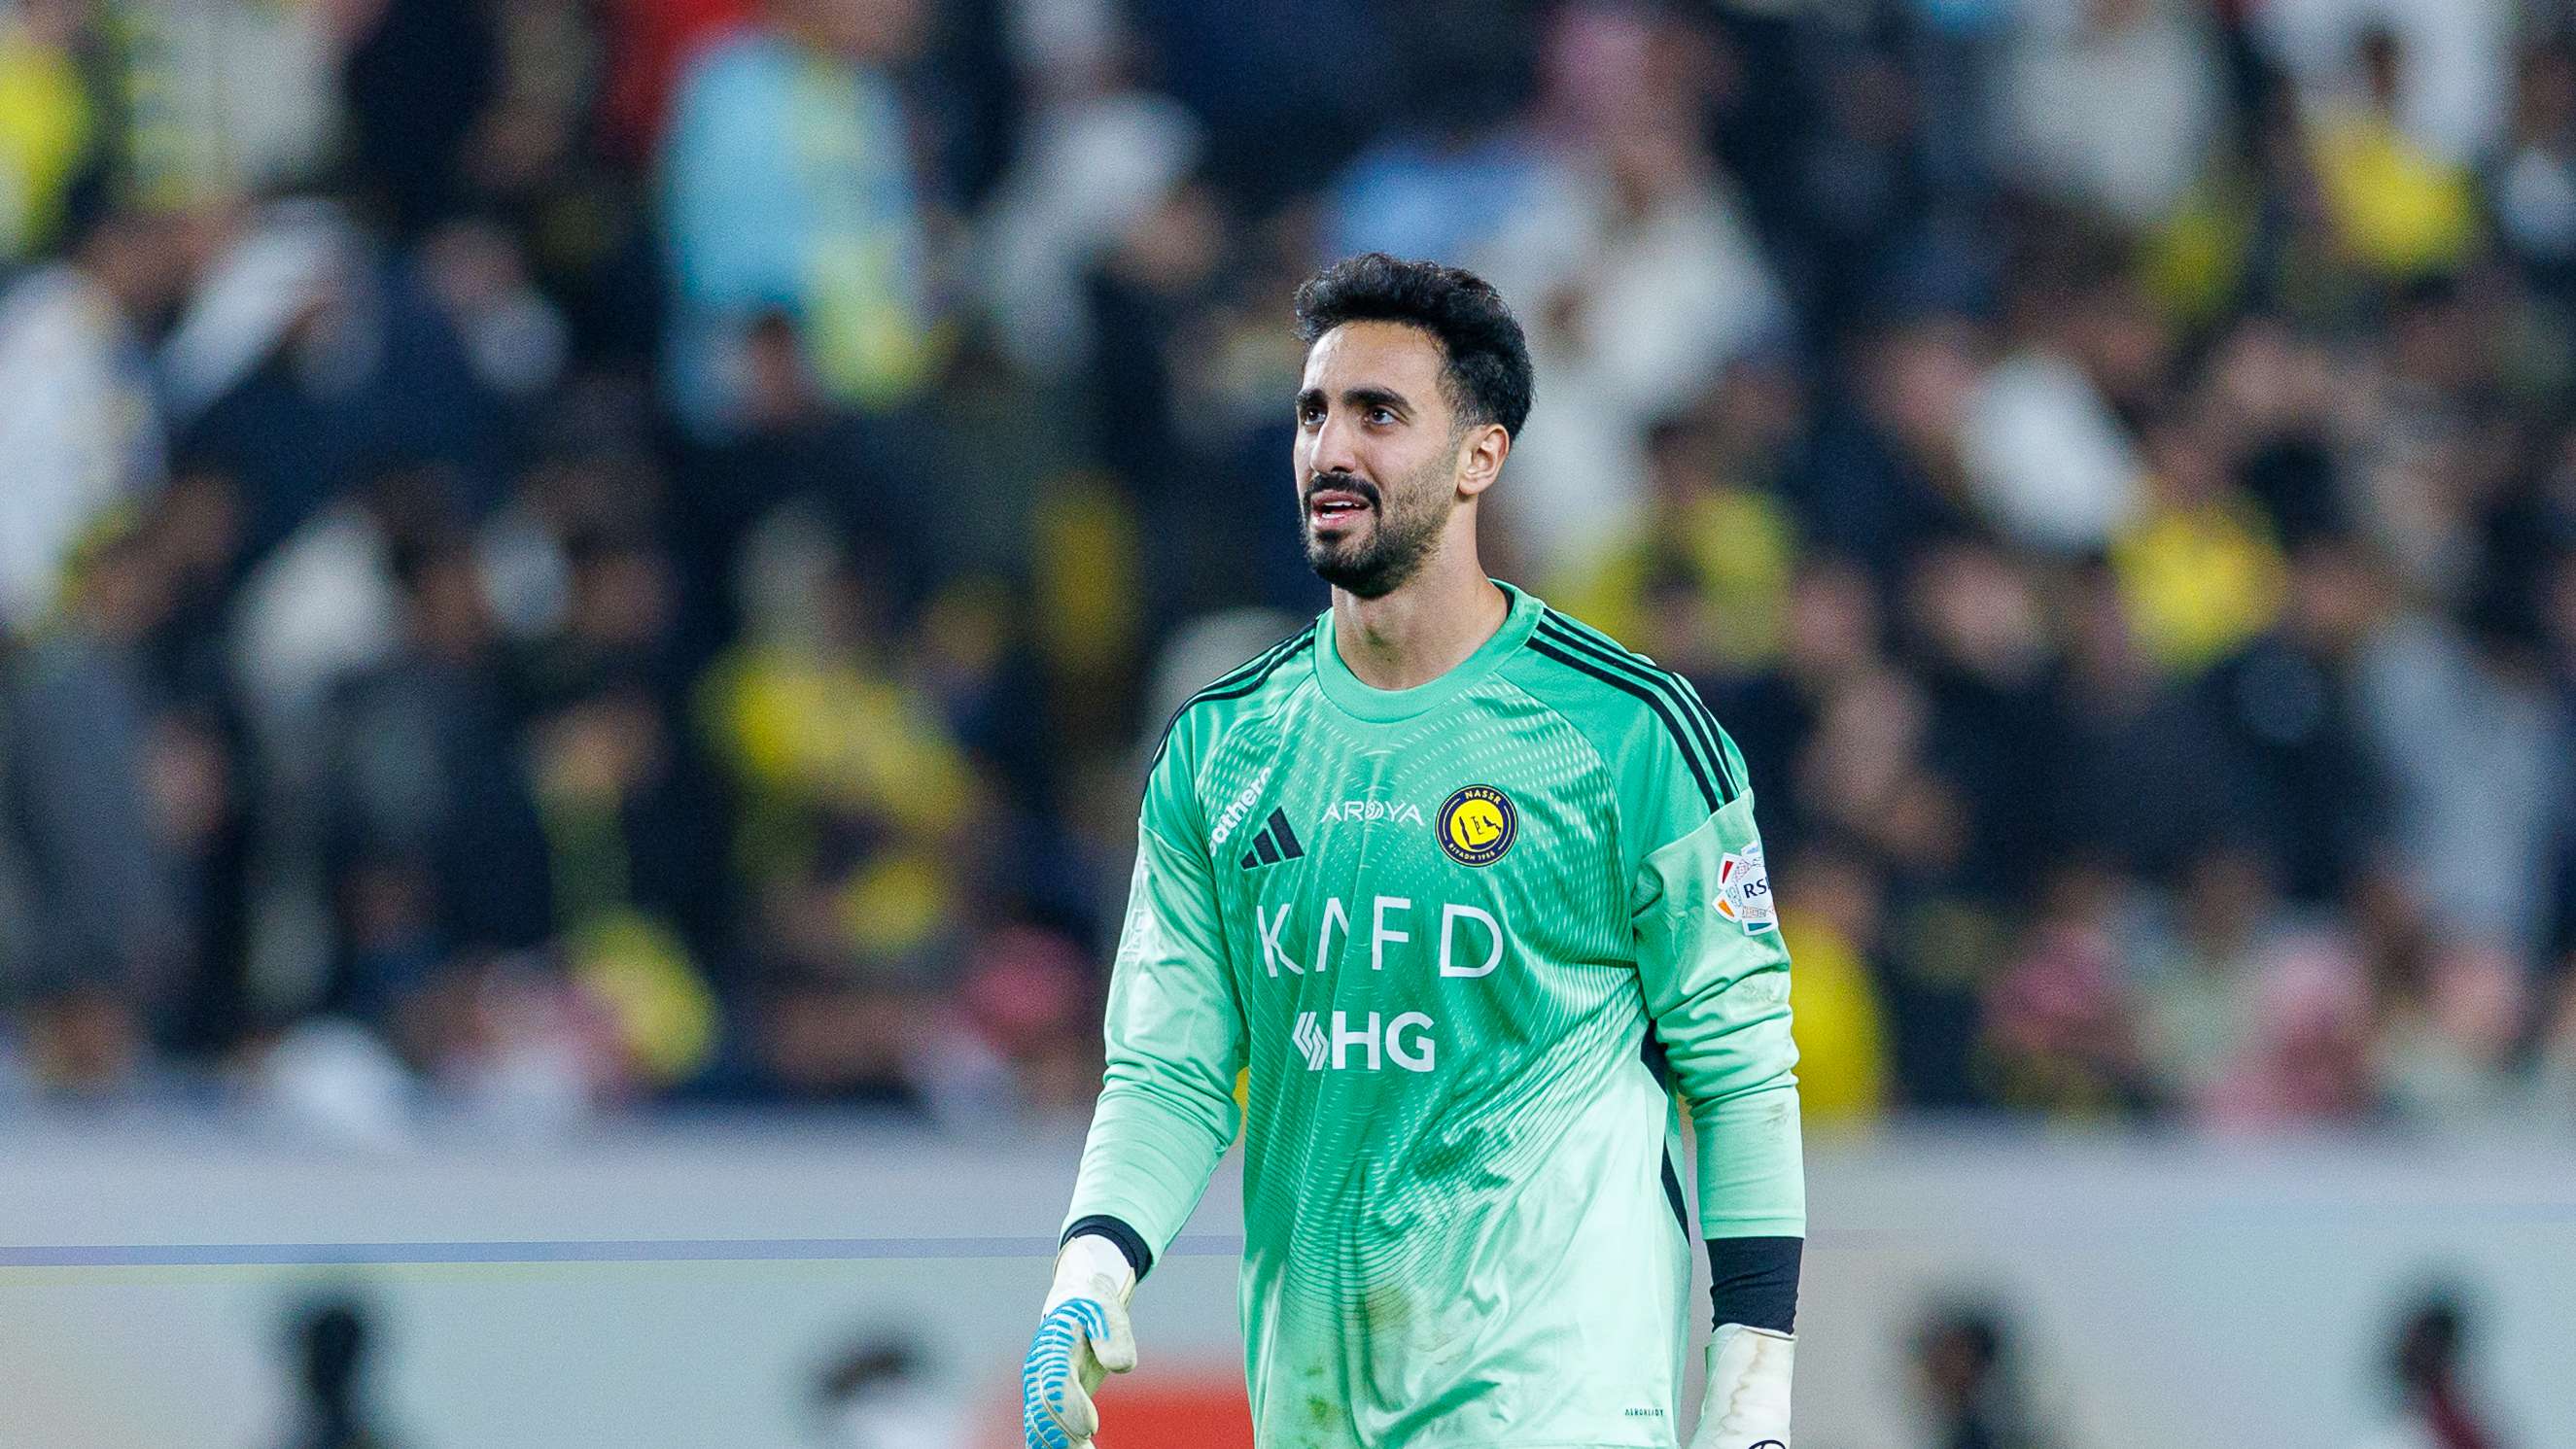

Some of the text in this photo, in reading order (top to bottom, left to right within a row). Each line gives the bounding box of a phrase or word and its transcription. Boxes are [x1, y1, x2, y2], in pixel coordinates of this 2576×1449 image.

[1465, 790, 1502, 805] NASSR
[1257, 896, 1504, 978] KAFD
[1332, 1011, 1436, 1073] HG
